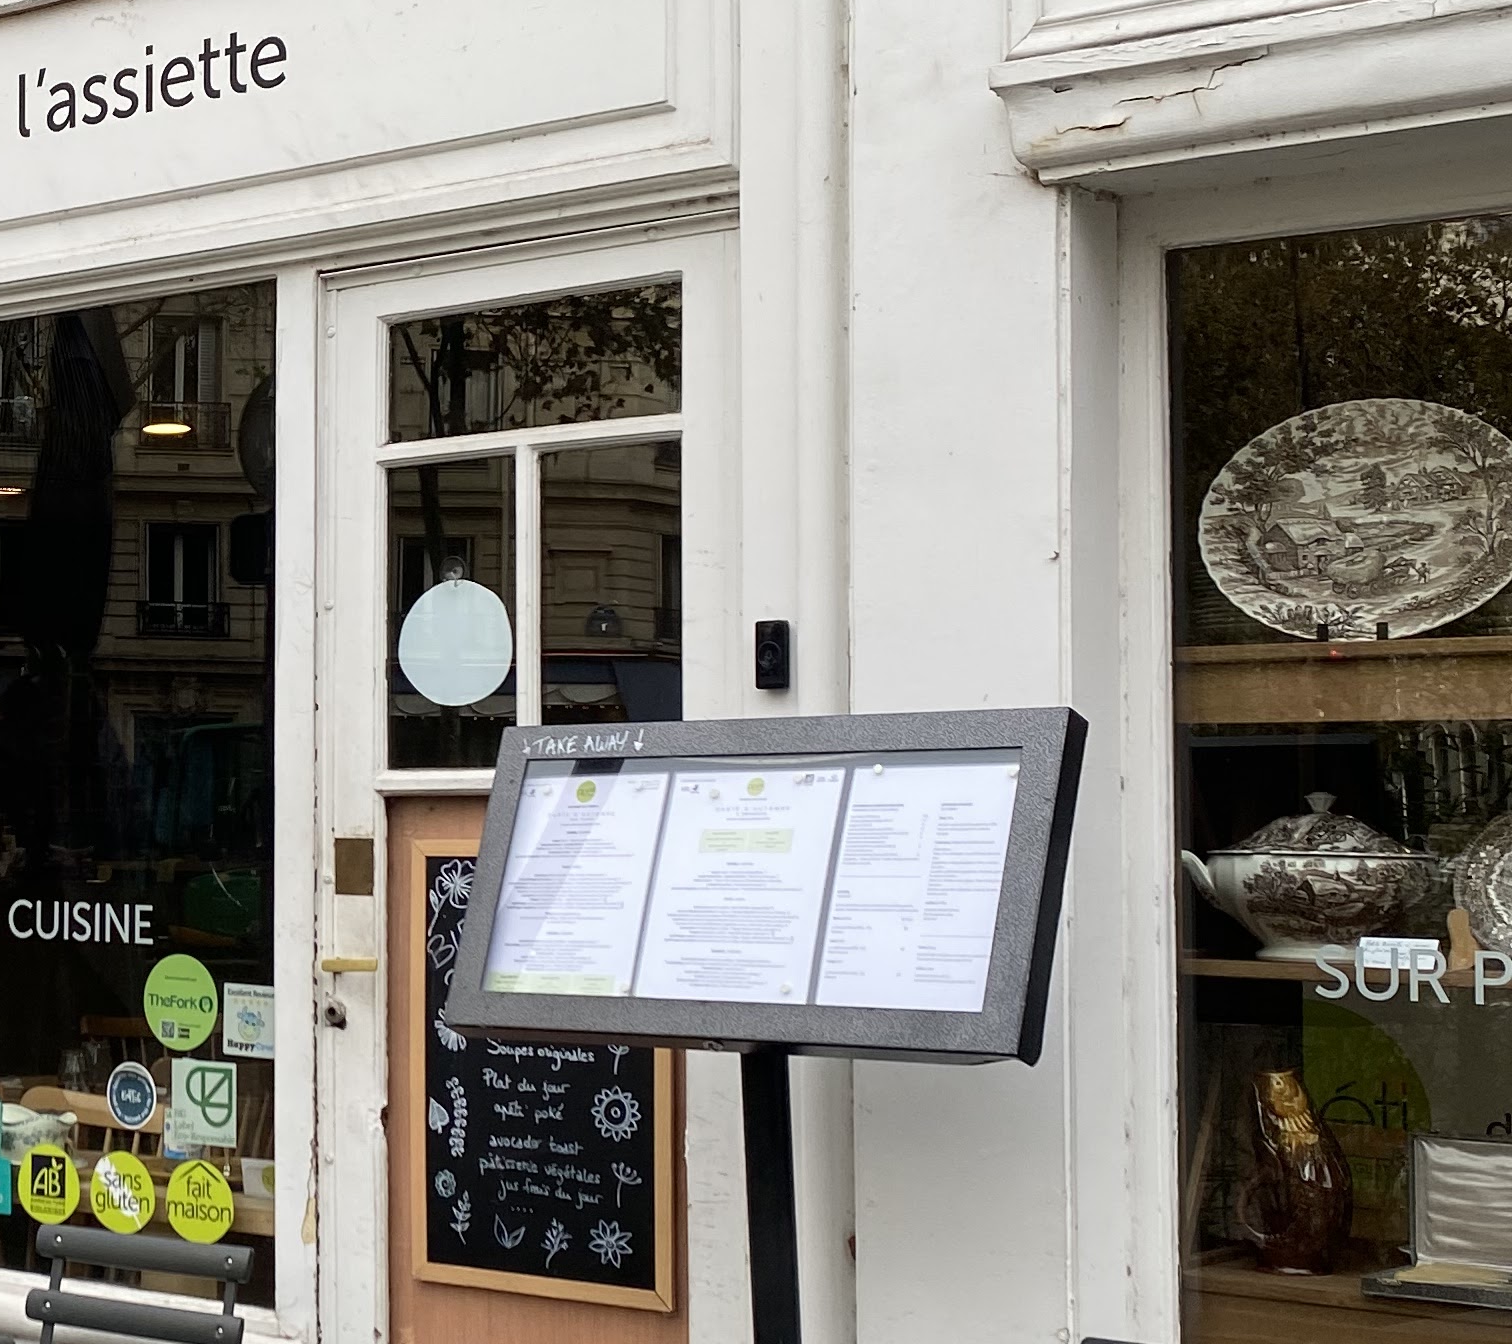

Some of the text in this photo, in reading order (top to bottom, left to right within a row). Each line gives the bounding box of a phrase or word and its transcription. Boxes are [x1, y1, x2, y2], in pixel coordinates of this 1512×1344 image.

[19, 32, 287, 138] l'assiette
[532, 730, 629, 755] TAKE AWAY
[9, 899, 154, 945] CUISINE
[1315, 944, 1451, 1004] SUR
[148, 993, 198, 1010] TheFork
[482, 1067, 571, 1101] Plat du jour
[33, 1166, 62, 1196] AB
[103, 1170, 142, 1192] sans
[187, 1174, 212, 1200] fait
[555, 1187, 572, 1201] du
[95, 1189, 150, 1215] gluten
[167, 1198, 232, 1224] maison
